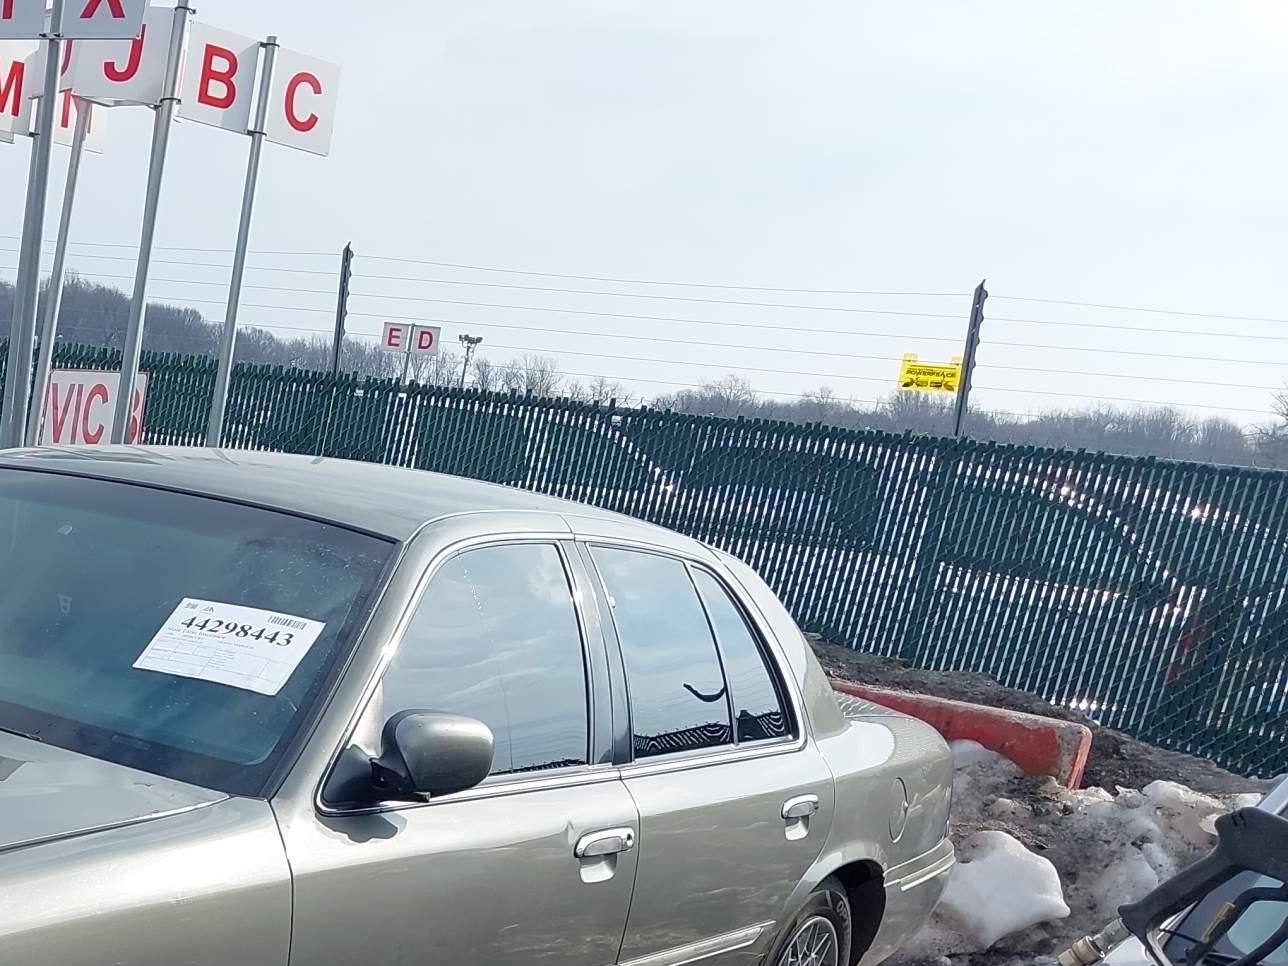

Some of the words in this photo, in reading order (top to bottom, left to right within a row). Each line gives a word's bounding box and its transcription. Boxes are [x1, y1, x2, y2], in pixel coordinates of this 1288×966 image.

[198, 44, 238, 110] B
[284, 71, 323, 133] C
[387, 327, 403, 348] E
[417, 330, 434, 350] D
[51, 382, 109, 445] VIC
[181, 616, 295, 646] 44298443
